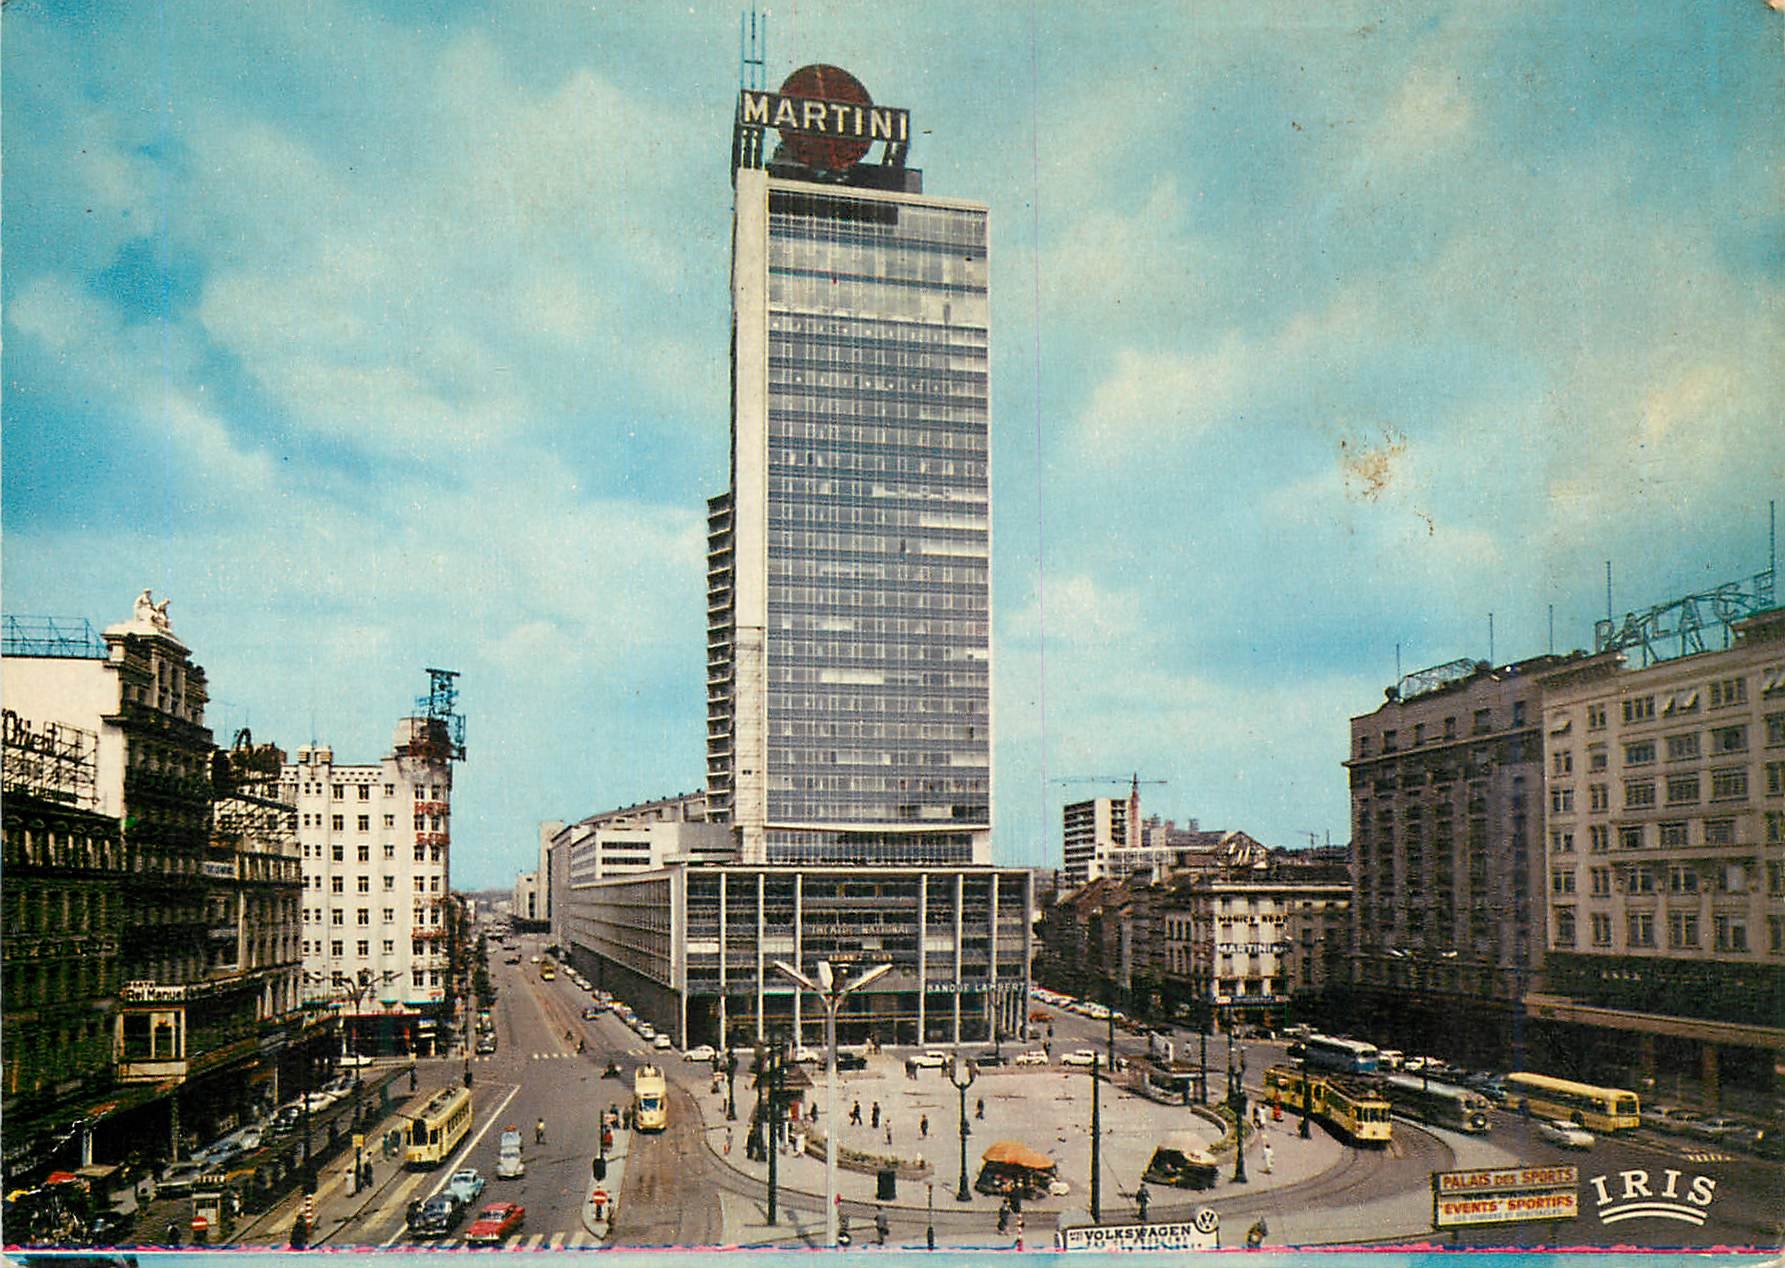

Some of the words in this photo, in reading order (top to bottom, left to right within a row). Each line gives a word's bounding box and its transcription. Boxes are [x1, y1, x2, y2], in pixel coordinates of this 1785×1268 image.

[743, 93, 907, 141] MARTINI
[1595, 568, 1776, 655] PALACE
[1216, 943, 1272, 954] MARTINI
[927, 983, 969, 993] BANQUE
[975, 982, 1025, 993] LAMBERT
[1442, 1175, 1491, 1188] PALAIS
[1521, 1168, 1574, 1183] SPORTS
[1507, 1195, 1573, 1210] SPORTIFS
[1084, 1225, 1191, 1240] VOLKSWAGEN
